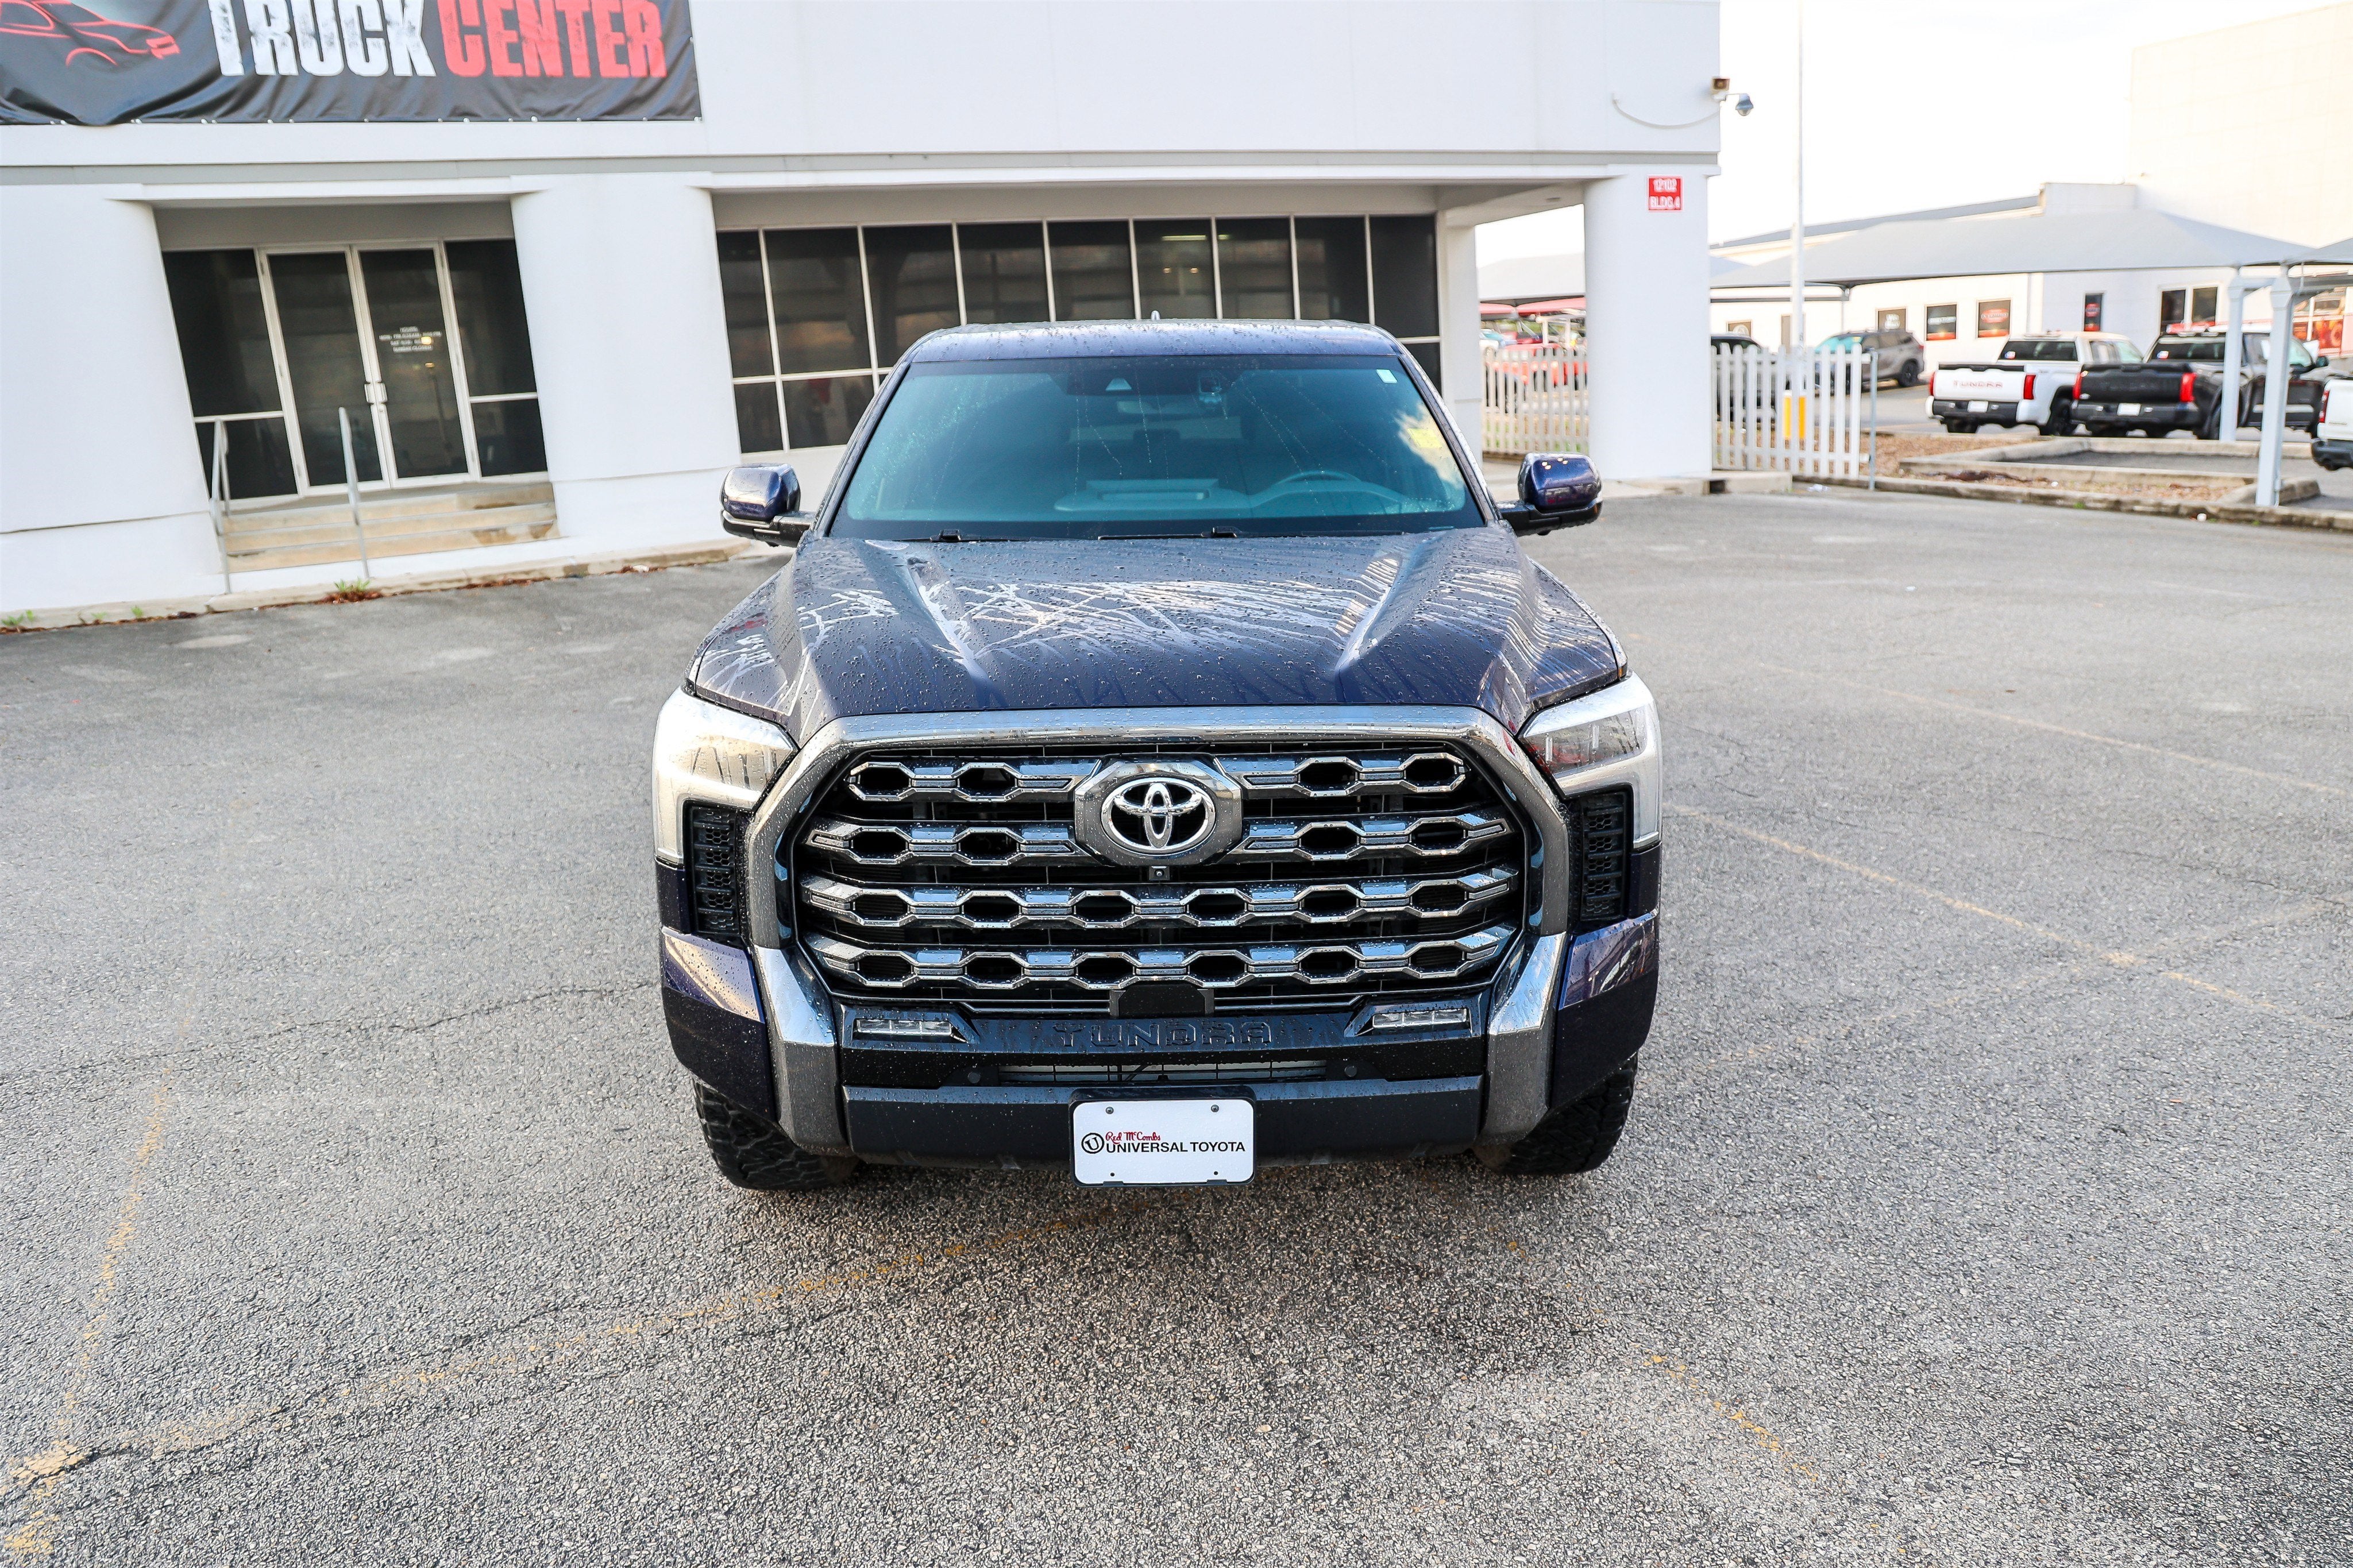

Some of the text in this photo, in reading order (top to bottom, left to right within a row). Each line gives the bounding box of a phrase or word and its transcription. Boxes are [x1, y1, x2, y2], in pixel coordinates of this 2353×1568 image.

[208, 0, 668, 78] TRUCK CENTER
[1052, 1021, 1271, 1047] TUNDRA
[1105, 1131, 1161, 1145] Red McCombs
[1106, 1142, 1188, 1153] UNIVERSAL
[1190, 1141, 1246, 1152] TOYOTA
